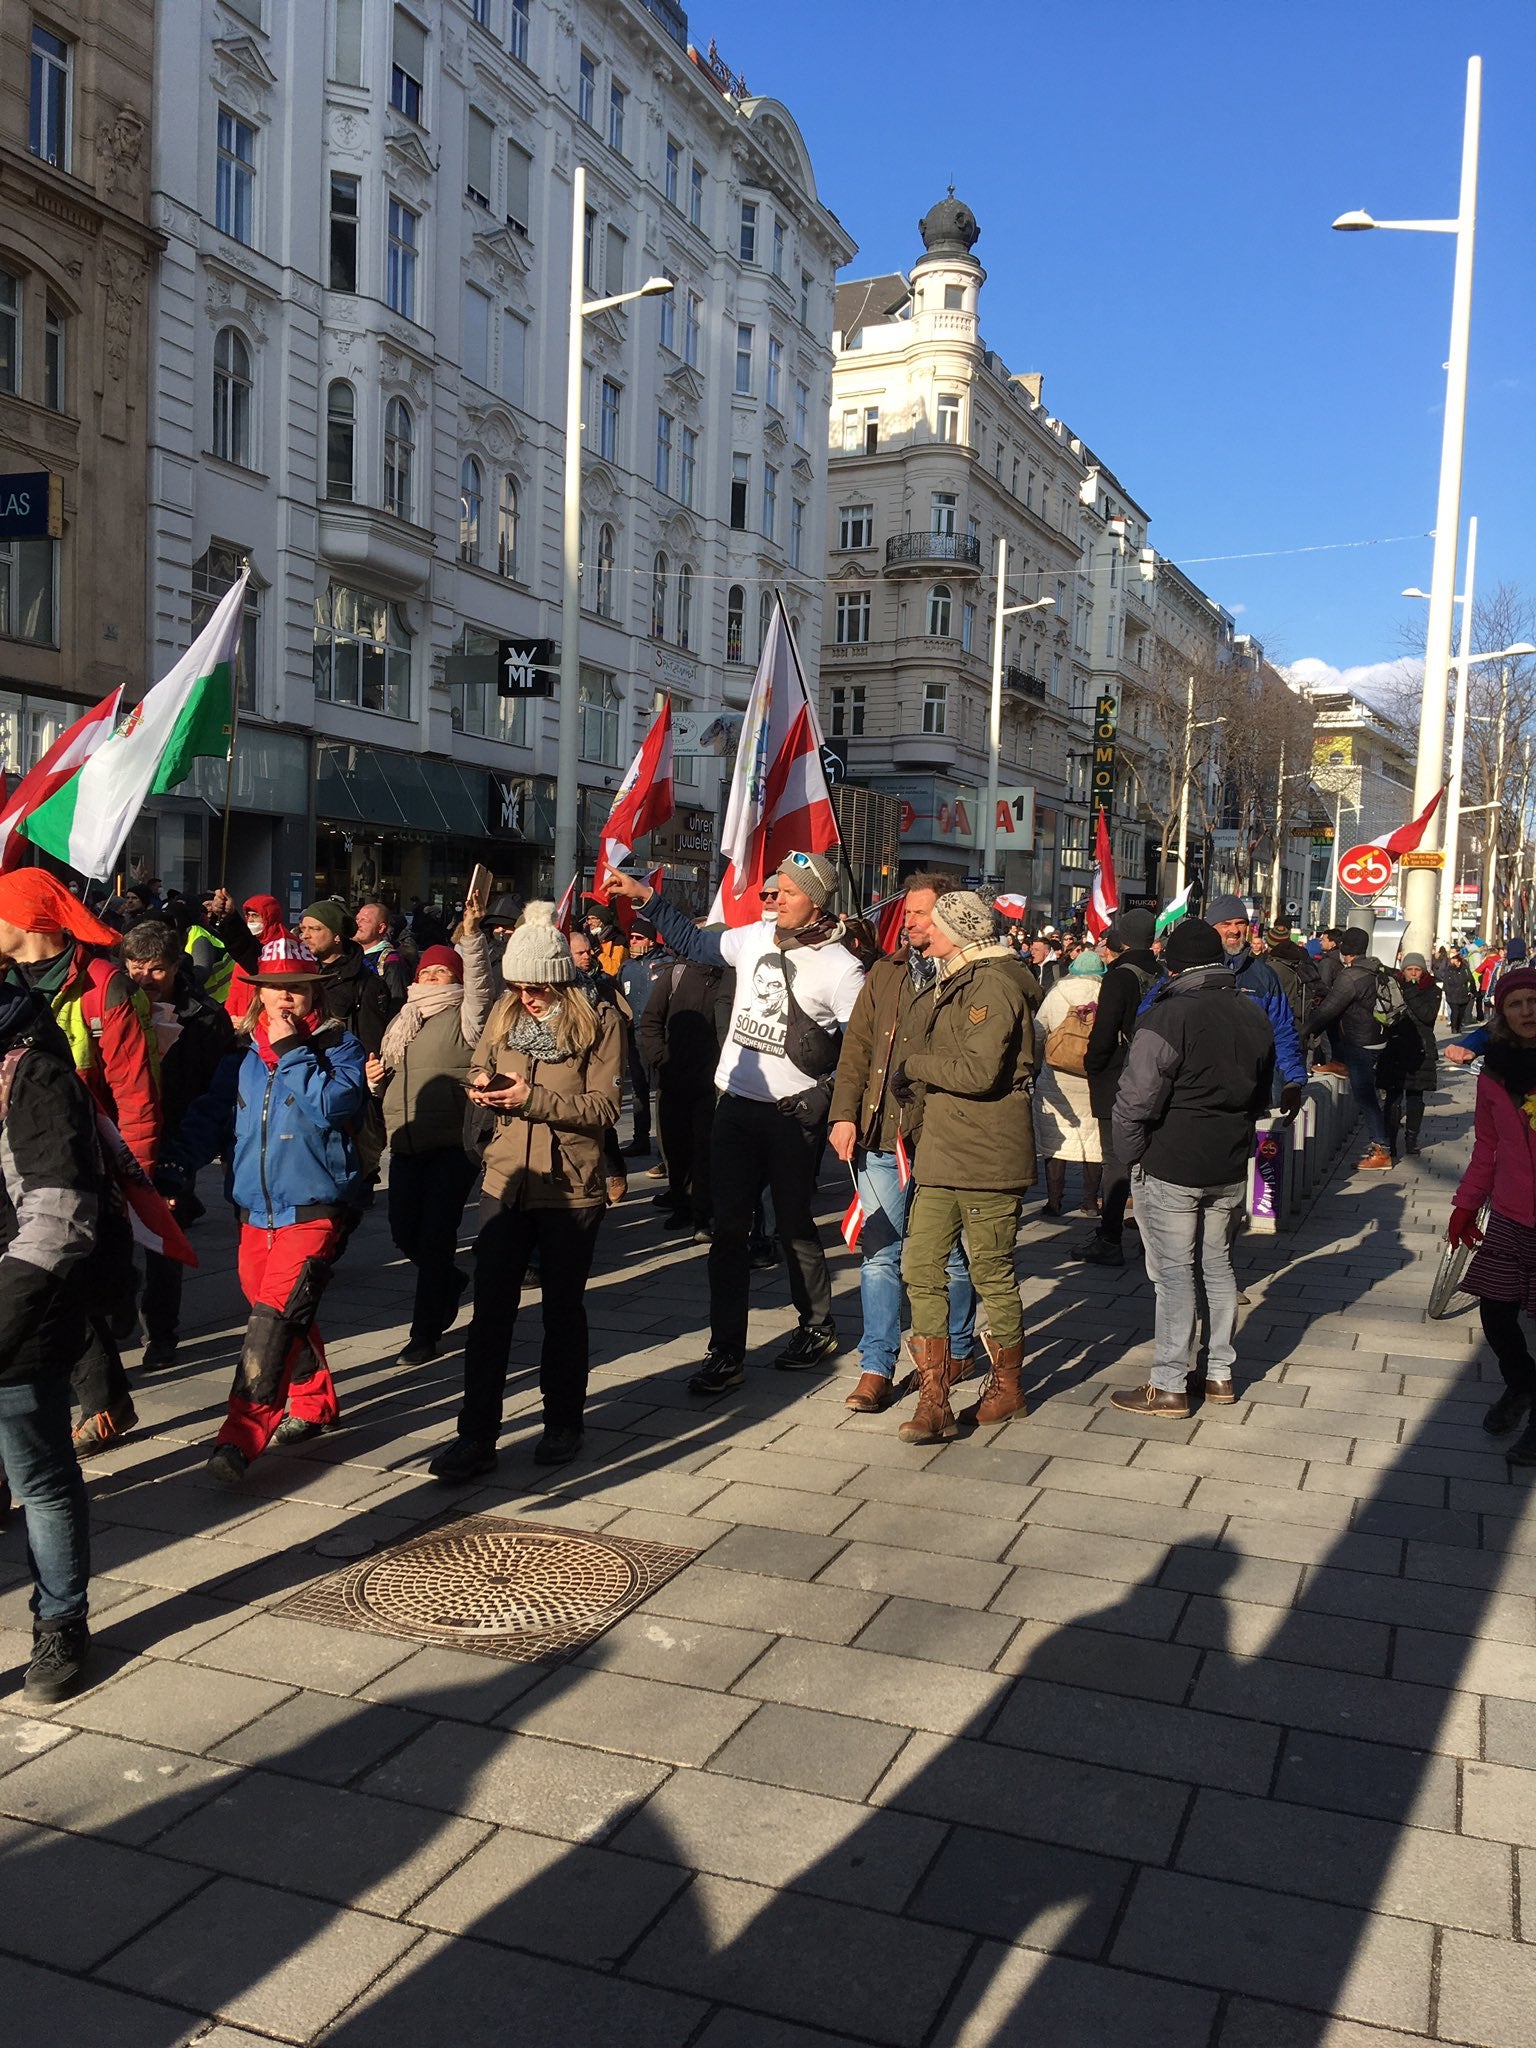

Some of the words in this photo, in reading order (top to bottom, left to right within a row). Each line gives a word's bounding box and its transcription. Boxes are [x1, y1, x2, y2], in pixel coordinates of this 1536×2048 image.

[1092, 700, 1116, 857] KOMOL
[996, 795, 1025, 833] A1
[736, 1013, 787, 1043] SÖDOLF
